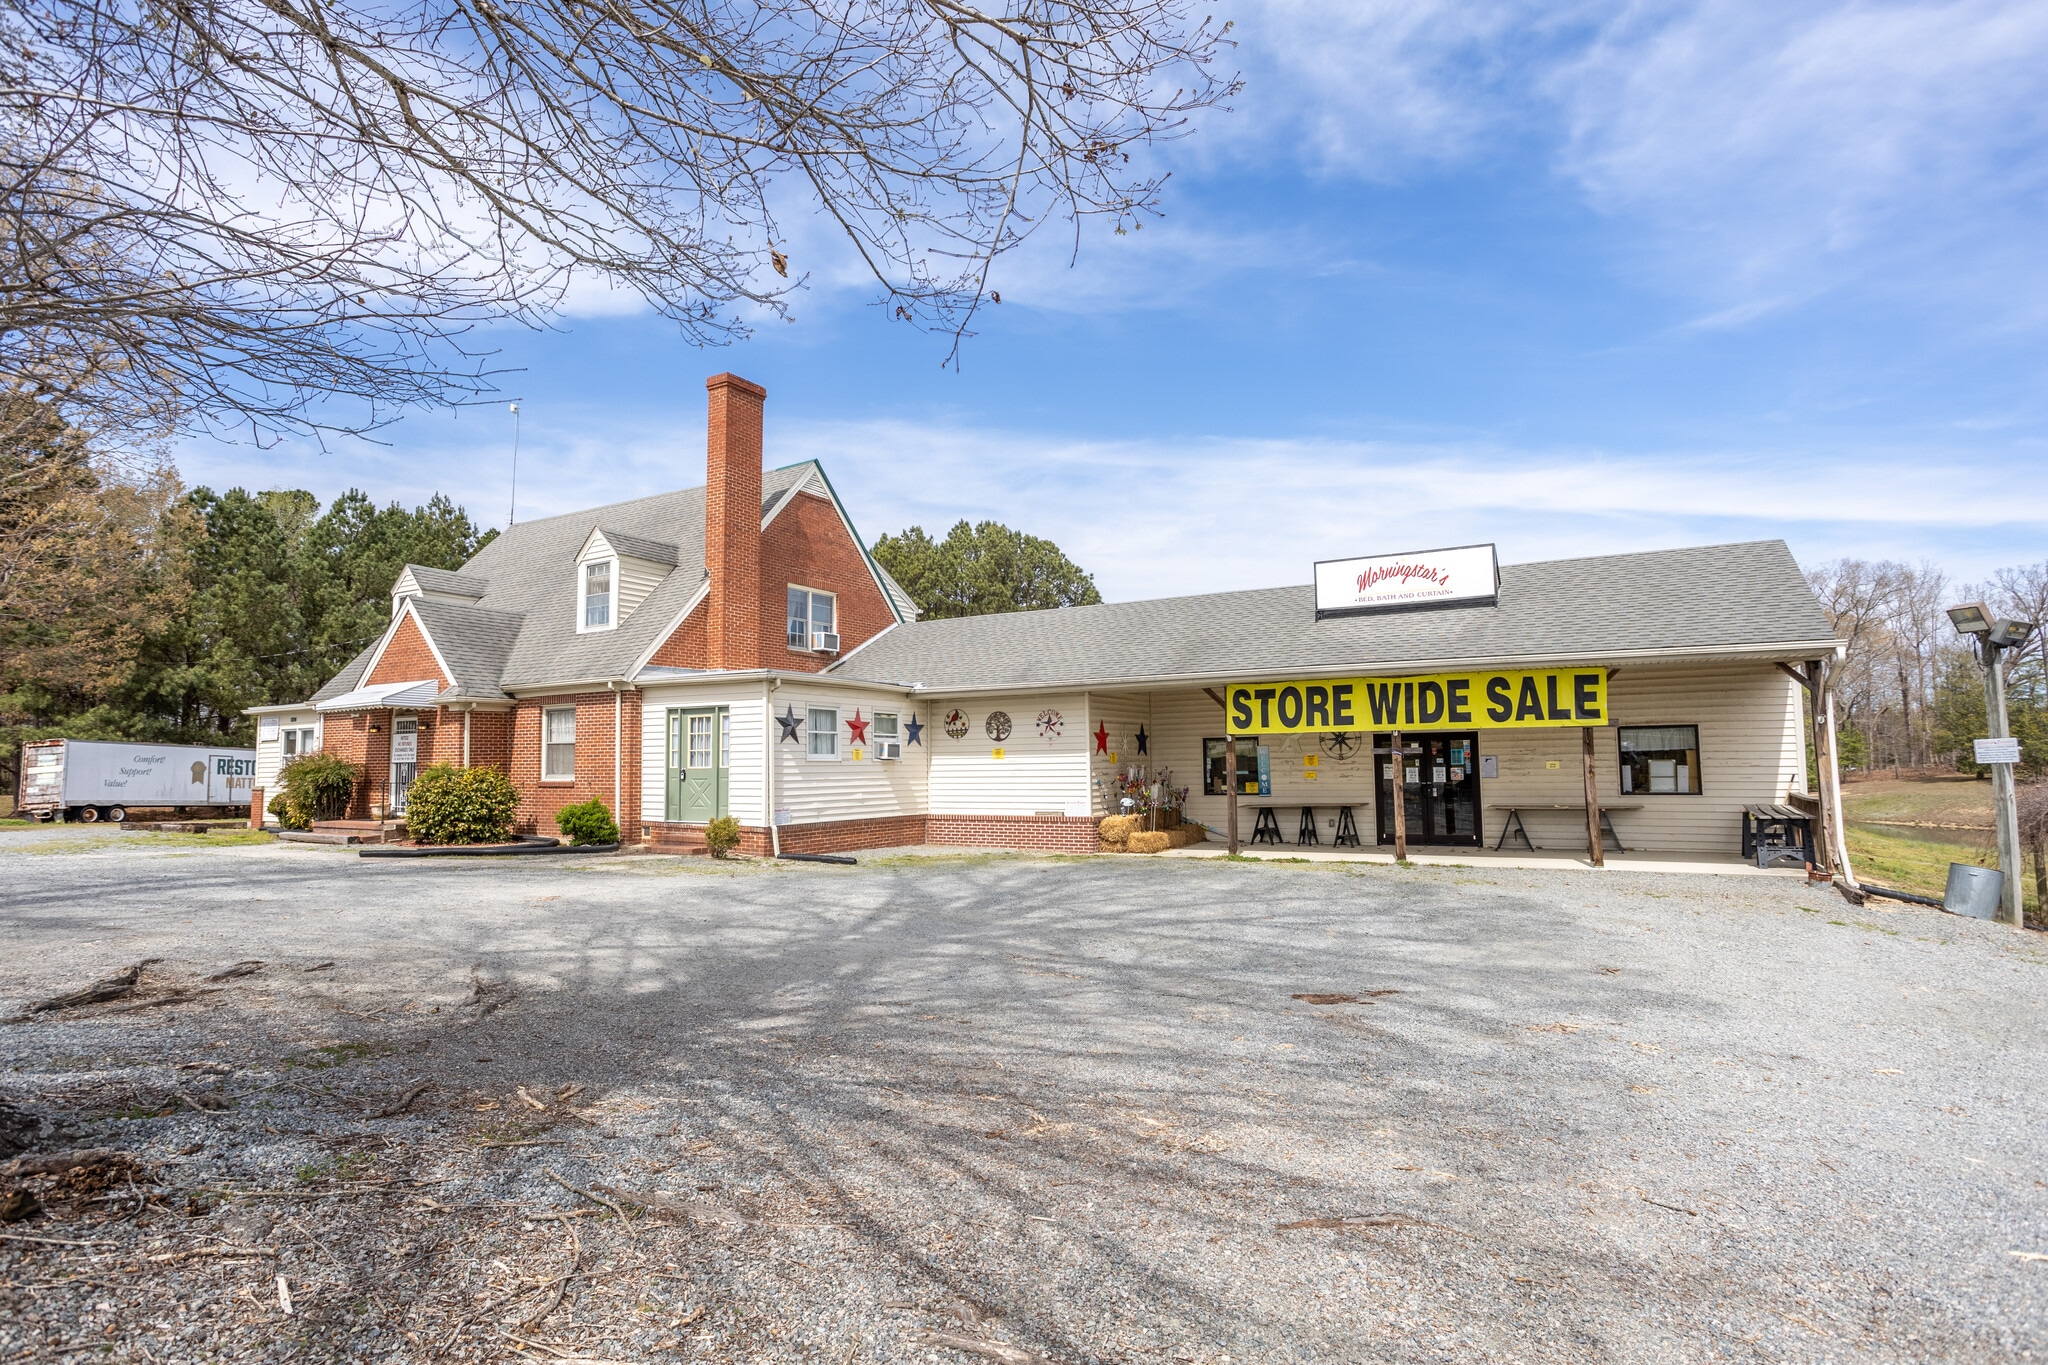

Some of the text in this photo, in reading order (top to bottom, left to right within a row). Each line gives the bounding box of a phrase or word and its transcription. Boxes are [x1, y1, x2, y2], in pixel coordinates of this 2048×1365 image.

[1357, 561, 1449, 593] Morningstar's
[1232, 674, 1601, 729] STORE WIDE SALE
[1036, 708, 1063, 721] WELCOME
[133, 755, 166, 765] Comfort!
[119, 767, 152, 777] Support!
[104, 779, 128, 788] Value!
[226, 777, 256, 789] MATT
